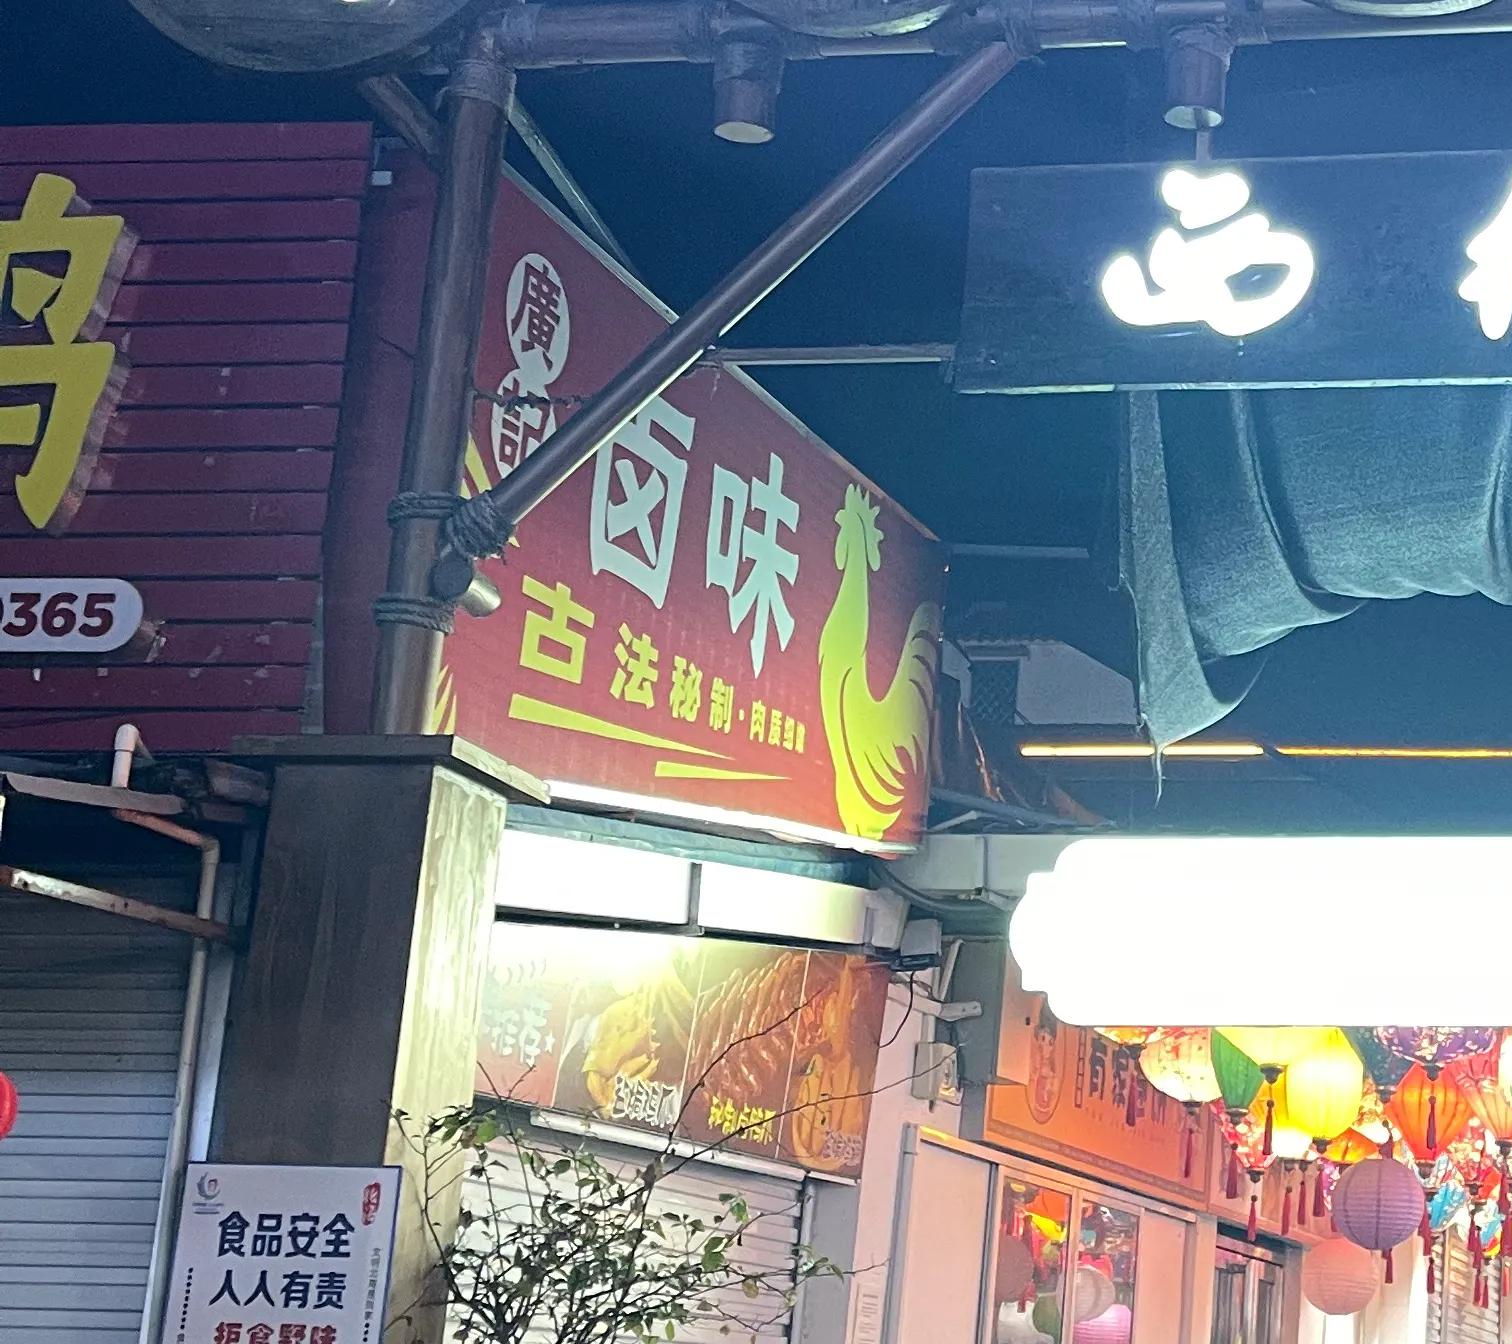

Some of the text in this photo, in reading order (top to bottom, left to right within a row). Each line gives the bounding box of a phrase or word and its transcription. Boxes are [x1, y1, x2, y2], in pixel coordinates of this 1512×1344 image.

[590, 396, 799, 680] 卤味
[0, 591, 117, 639] 365
[216, 1210, 356, 1259] 食品安全
[208, 1269, 348, 1310] 人人有责
